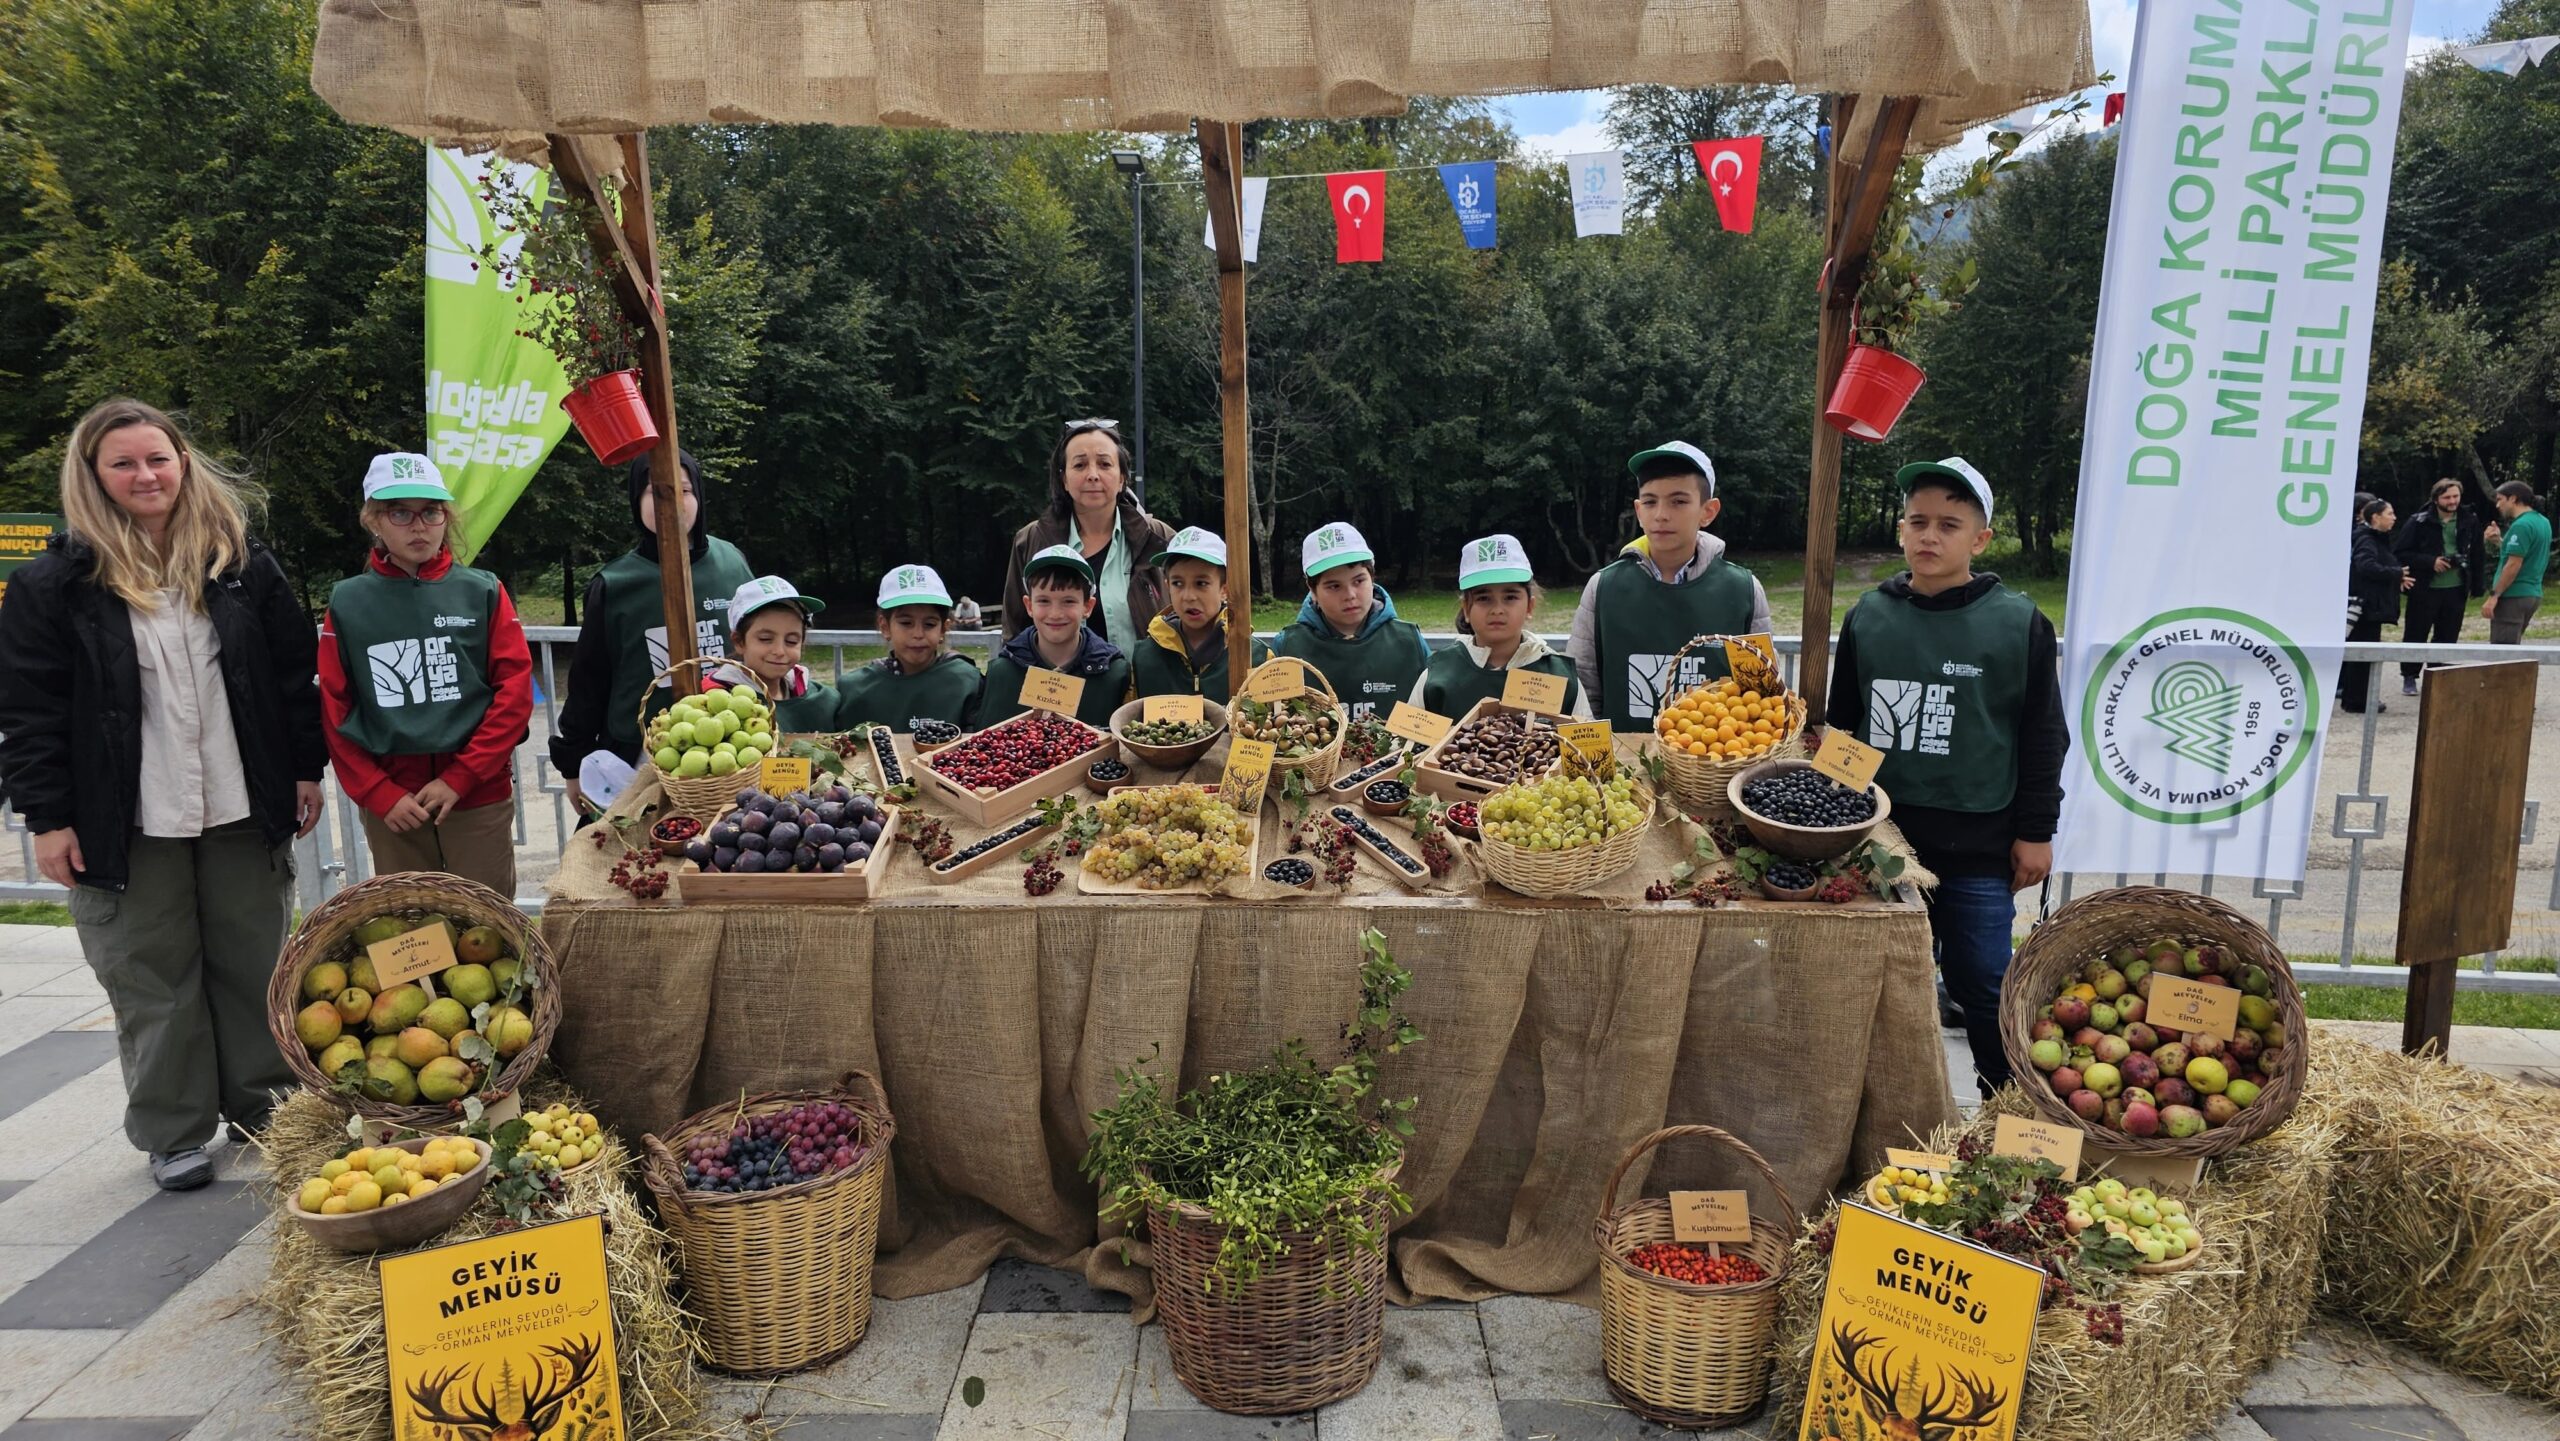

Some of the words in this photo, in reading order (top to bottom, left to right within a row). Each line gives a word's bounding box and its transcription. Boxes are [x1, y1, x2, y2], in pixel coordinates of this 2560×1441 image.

[2208, 268, 2278, 438] MİLLİ
[2126, 292, 2202, 487] DOĞA
[2276, 305, 2350, 527] GENEL
[0, 525, 53, 536] KLENEN
[0, 539, 48, 554] NUÇLA
[695, 618, 720, 637] or
[424, 635, 452, 655] or
[2139, 629, 2203, 658] GENEL
[425, 652, 458, 667] man
[1680, 656, 1706, 674] or
[2210, 629, 2298, 710] MÜDÜRLÜĞÜ
[427, 664, 459, 688] ya
[1679, 673, 1707, 686] man
[1925, 684, 1955, 704] or
[2104, 658, 2140, 738] PARKLAR
[1922, 702, 1956, 717] man
[2244, 701, 2262, 738] 1958
[1920, 714, 1953, 738] ya
[2103, 742, 2140, 786] MİLLİ
[2250, 732, 2290, 779] DOĞA
[2139, 781, 2160, 800] VE
[2168, 776, 2250, 804] KORUMA
[391, 940, 429, 956] MEYVELERİ
[399, 936, 415, 946] DAĞ
[403, 959, 431, 974] Armut
[2173, 992, 2217, 1006] MEYVELERİ
[2186, 986, 2204, 994] DAĞ
[2178, 1013, 2203, 1025] Elma
[2018, 1132, 2059, 1146] MEYVELERİ
[1691, 1203, 1728, 1211] MEYVELERİ
[452, 1251, 538, 1287] GEYİK
[1893, 1247, 1974, 1291] GEYİK
[439, 1272, 561, 1319] MENÜSÜ
[1876, 1268, 1988, 1325] MENÜSÜ
[436, 1317, 511, 1342] GEYİKLERİN
[517, 1302, 568, 1324] SEVDİĞİ
[442, 1333, 491, 1352] ORMAN
[497, 1315, 566, 1339] MEYVELERİ
[1866, 1295, 1932, 1328] GEYİKLERİN
[1936, 1322, 1986, 1349] SEVDİĞİ
[1868, 1307, 1911, 1331] ORMAN
[1915, 1325, 1980, 1358] MEYVELERİ
